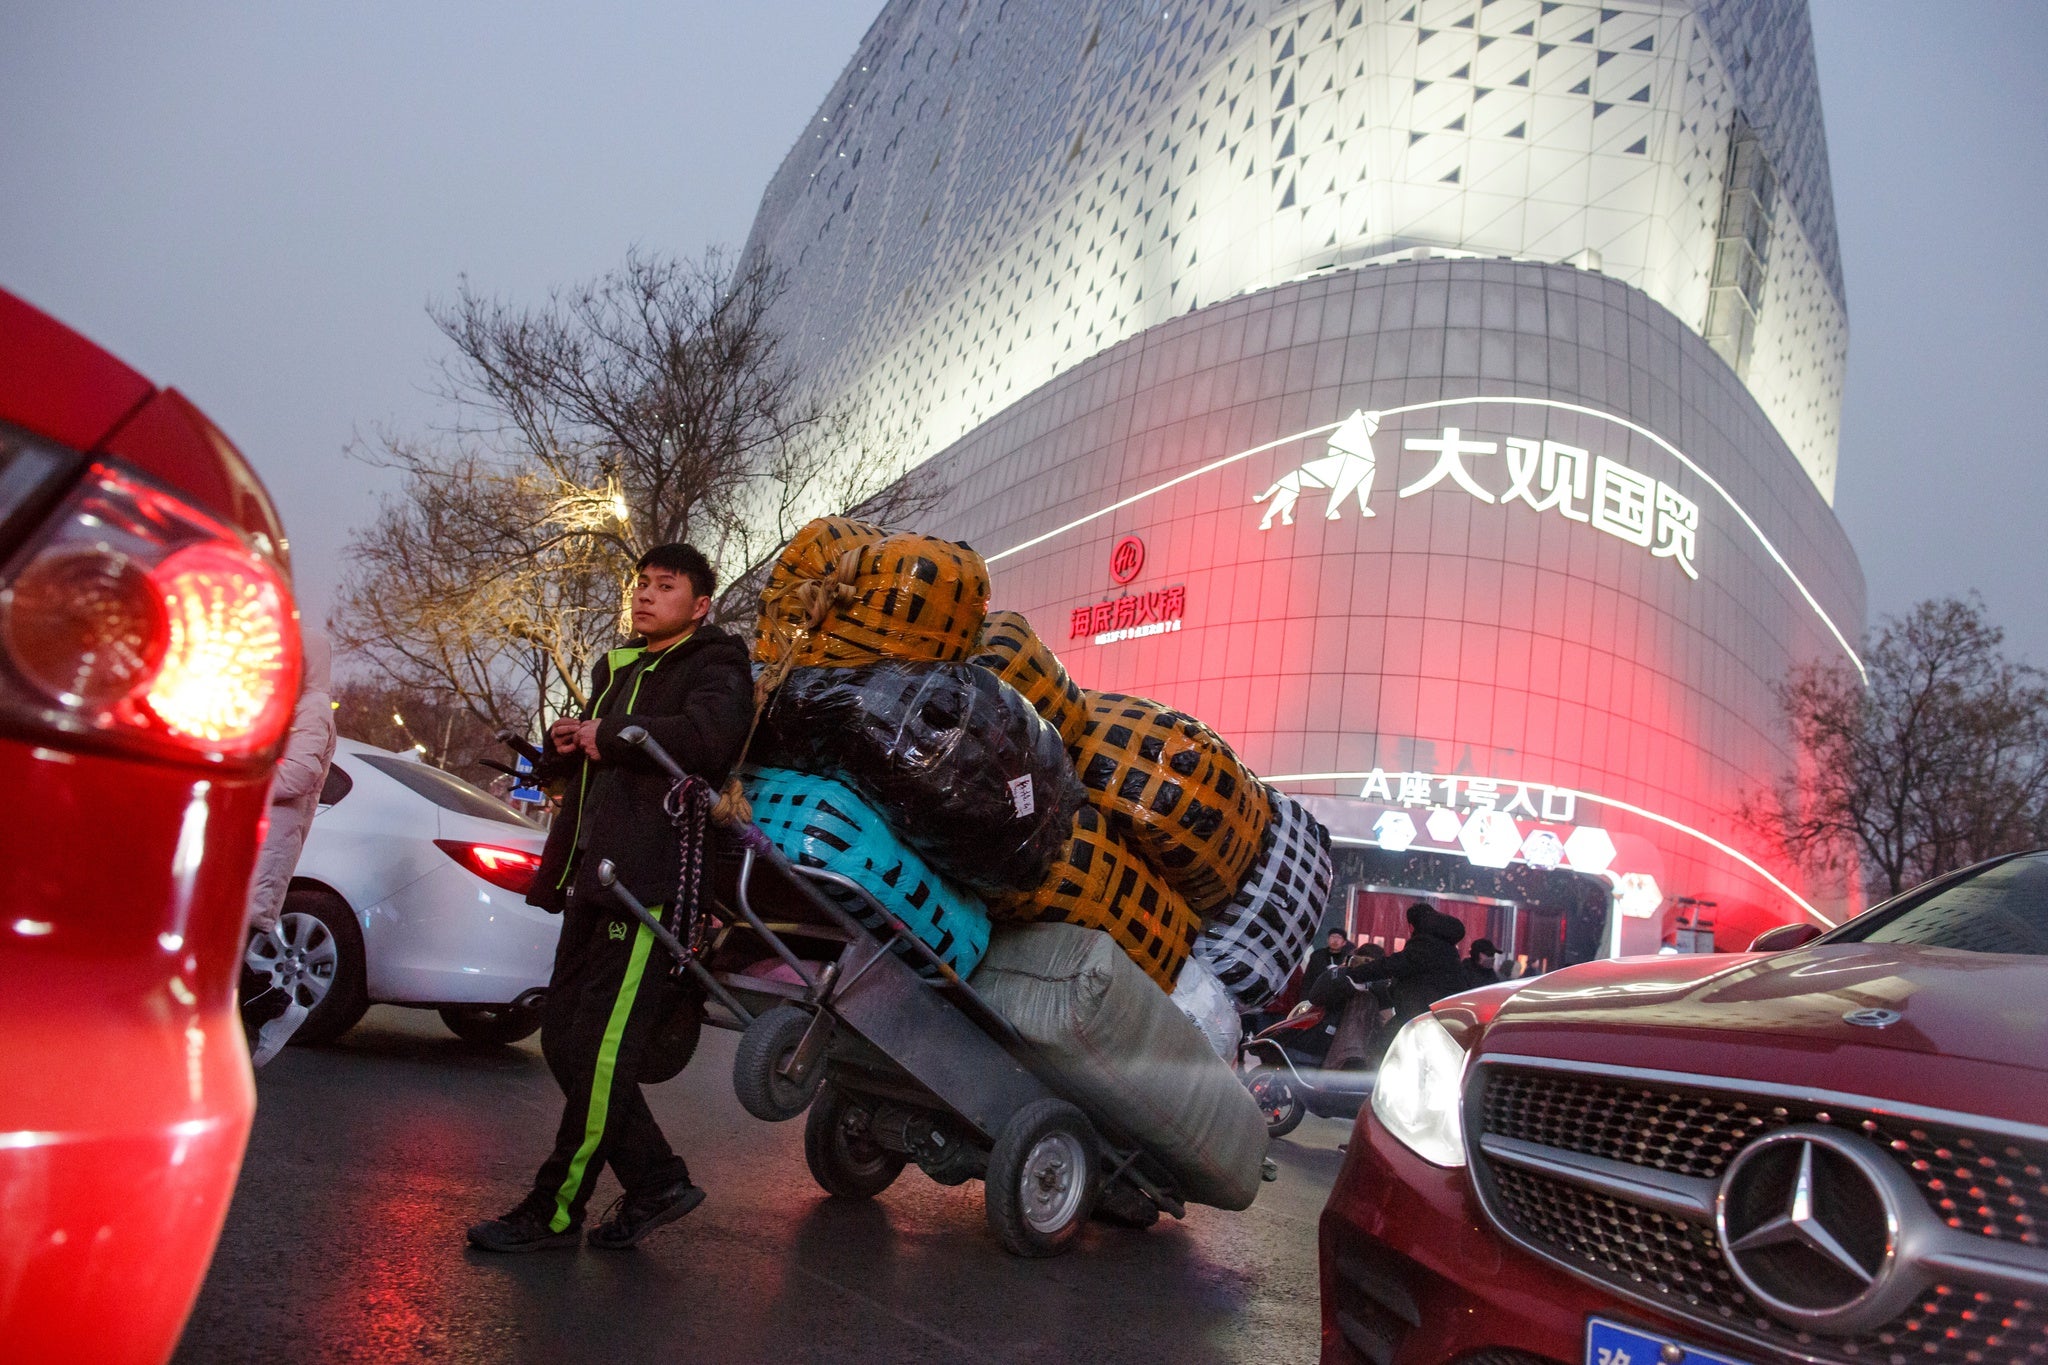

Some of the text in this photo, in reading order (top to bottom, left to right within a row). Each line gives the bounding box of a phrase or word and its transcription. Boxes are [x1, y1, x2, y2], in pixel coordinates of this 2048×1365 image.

[1399, 427, 1699, 580] 大观国贸
[1070, 586, 1185, 639] 海底捞火锅
[1360, 768, 1576, 821] A座1号入口
